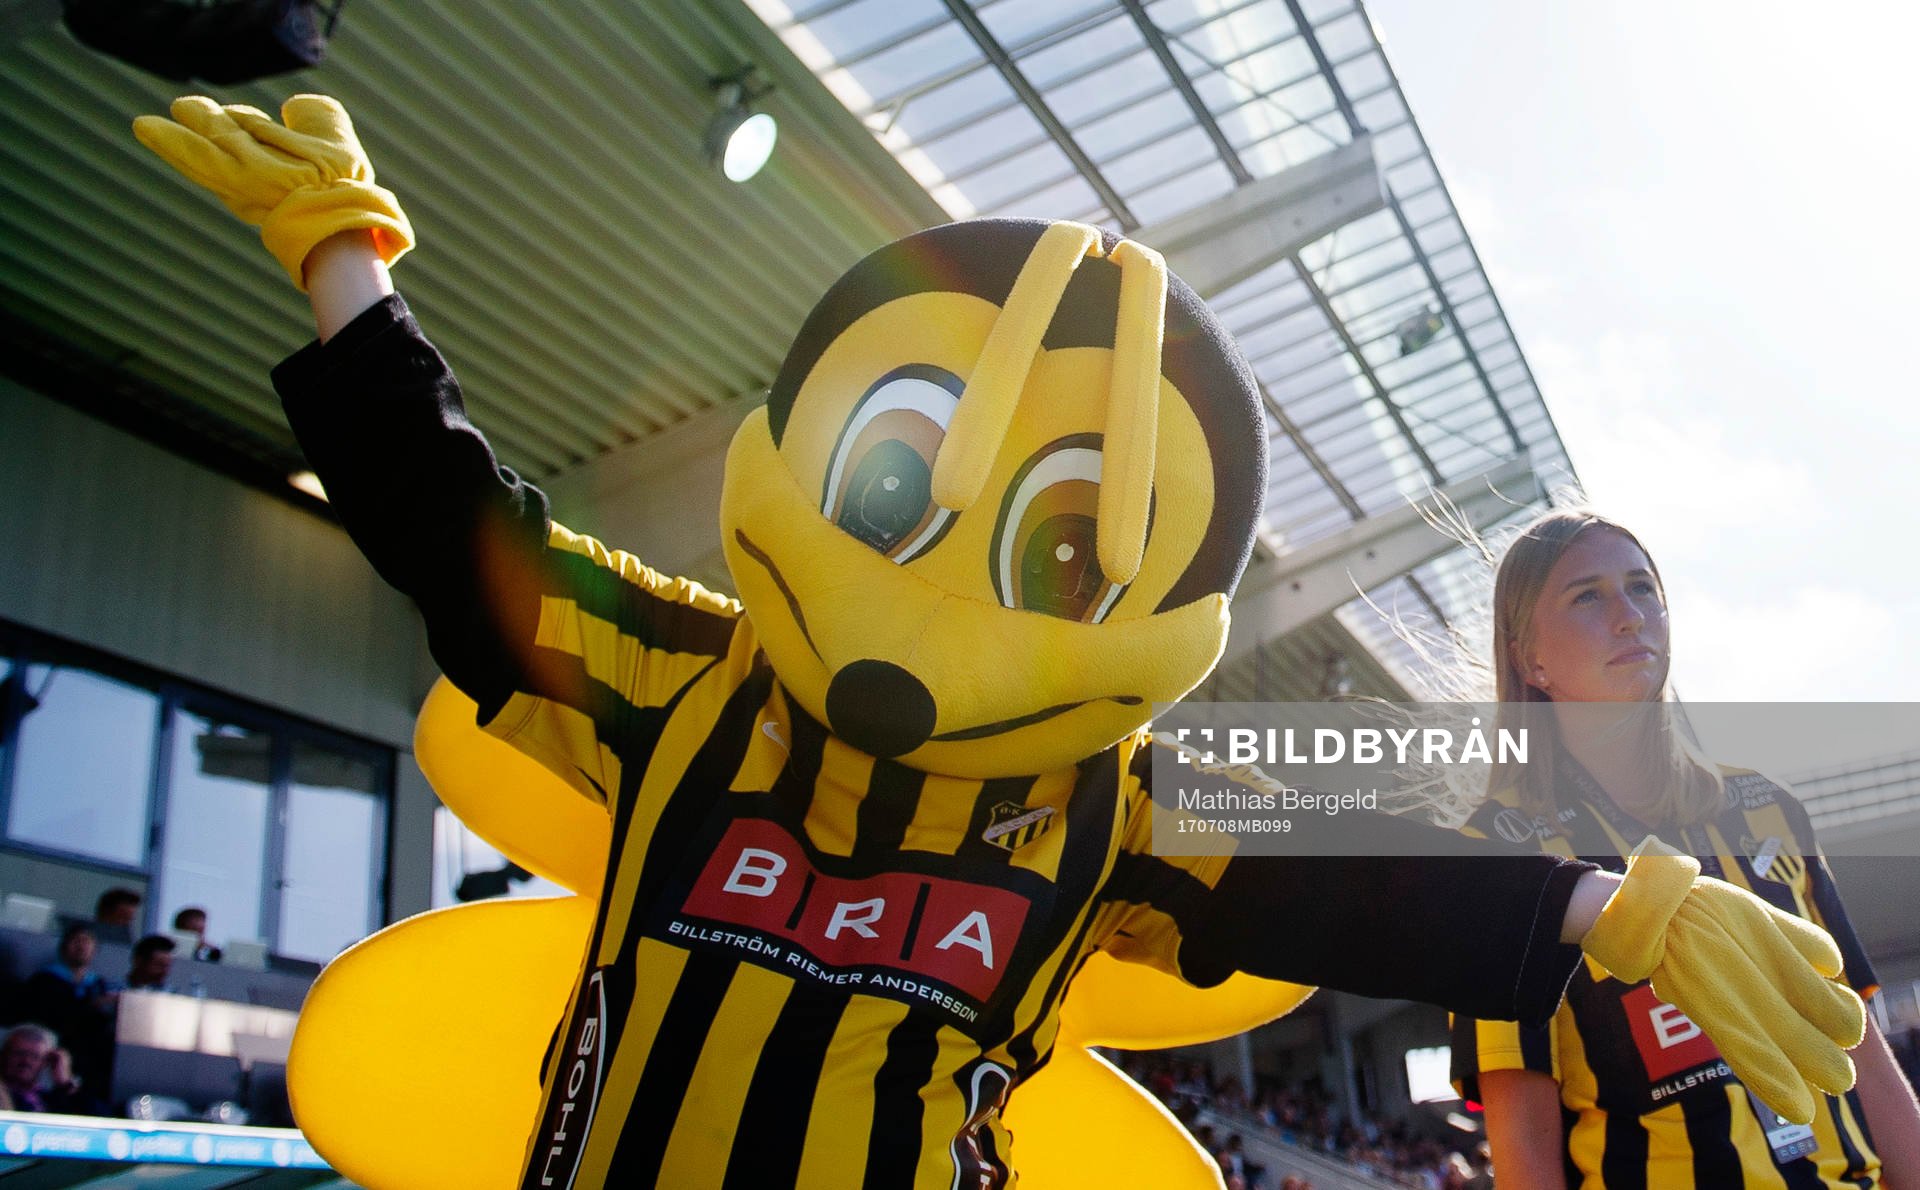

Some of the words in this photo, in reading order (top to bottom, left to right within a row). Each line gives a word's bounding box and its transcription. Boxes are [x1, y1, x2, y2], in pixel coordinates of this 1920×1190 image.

[722, 847, 993, 970] BRA
[668, 920, 781, 959] BILLSTRÖM
[786, 951, 863, 985] RIEMER
[869, 972, 979, 1023] ANDERSSON
[1651, 1062, 1735, 1101] BILLSTRÖ
